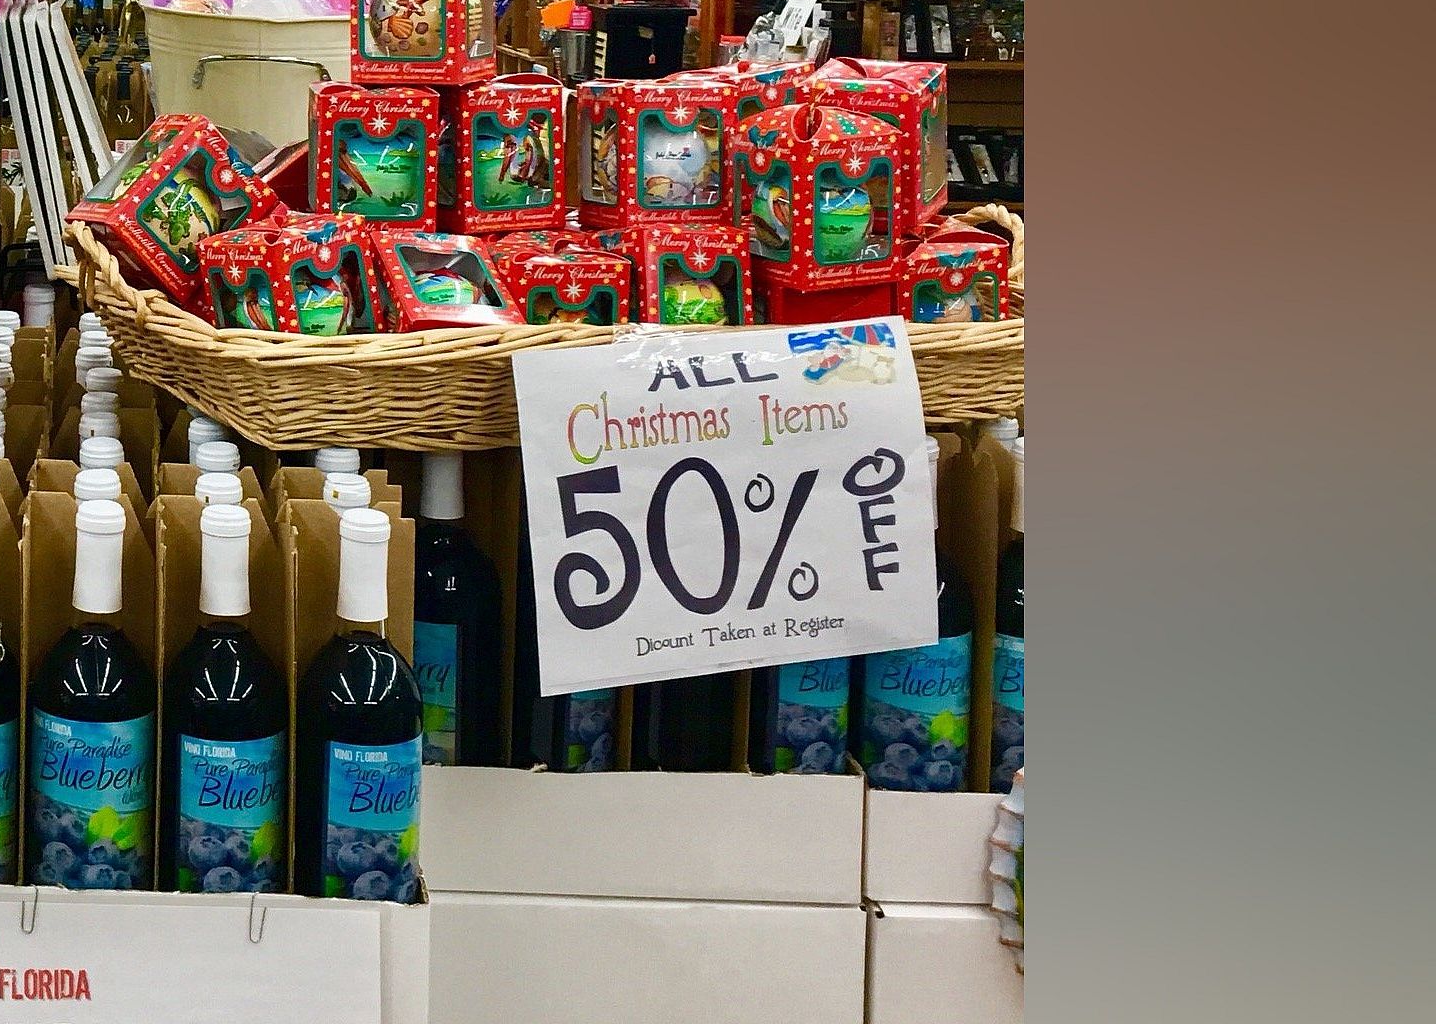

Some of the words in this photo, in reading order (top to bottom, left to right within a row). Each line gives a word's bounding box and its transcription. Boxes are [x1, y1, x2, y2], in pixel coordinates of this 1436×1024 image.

[358, 62, 400, 74] Collectible
[403, 61, 447, 74] Ornament
[468, 93, 504, 108] Merry
[507, 91, 552, 105] Christmas
[635, 91, 673, 105] Merry
[676, 90, 723, 103] Christmas
[329, 102, 370, 116] Merry
[373, 99, 425, 114] Christmas
[201, 129, 230, 162] Merry
[816, 143, 848, 157] Merry
[850, 139, 892, 153] Christmas
[473, 213, 514, 225] Collectible
[654, 235, 690, 249] Merry
[693, 235, 739, 249] Christmas
[201, 249, 226, 263] Merry
[228, 249, 264, 262] Christmas
[524, 268, 565, 282] Merry
[569, 266, 619, 280] Christmas
[647, 352, 780, 392] ALL
[567, 391, 731, 465] Christmas
[759, 394, 850, 447] Items
[841, 447, 906, 592] OFF
[553, 457, 820, 631] 50%
[636, 632, 695, 657] Dicount
[702, 622, 757, 647] Taken
[763, 623, 777, 637] at
[784, 617, 846, 638] Register
[68, 735, 133, 762] Paradise
[183, 741, 201, 756] VINO
[203, 743, 237, 759] FLORIDA
[334, 748, 353, 761] VINO
[356, 750, 388, 763] FLORIDA
[192, 754, 229, 777] Pure
[341, 761, 381, 782] Pure
